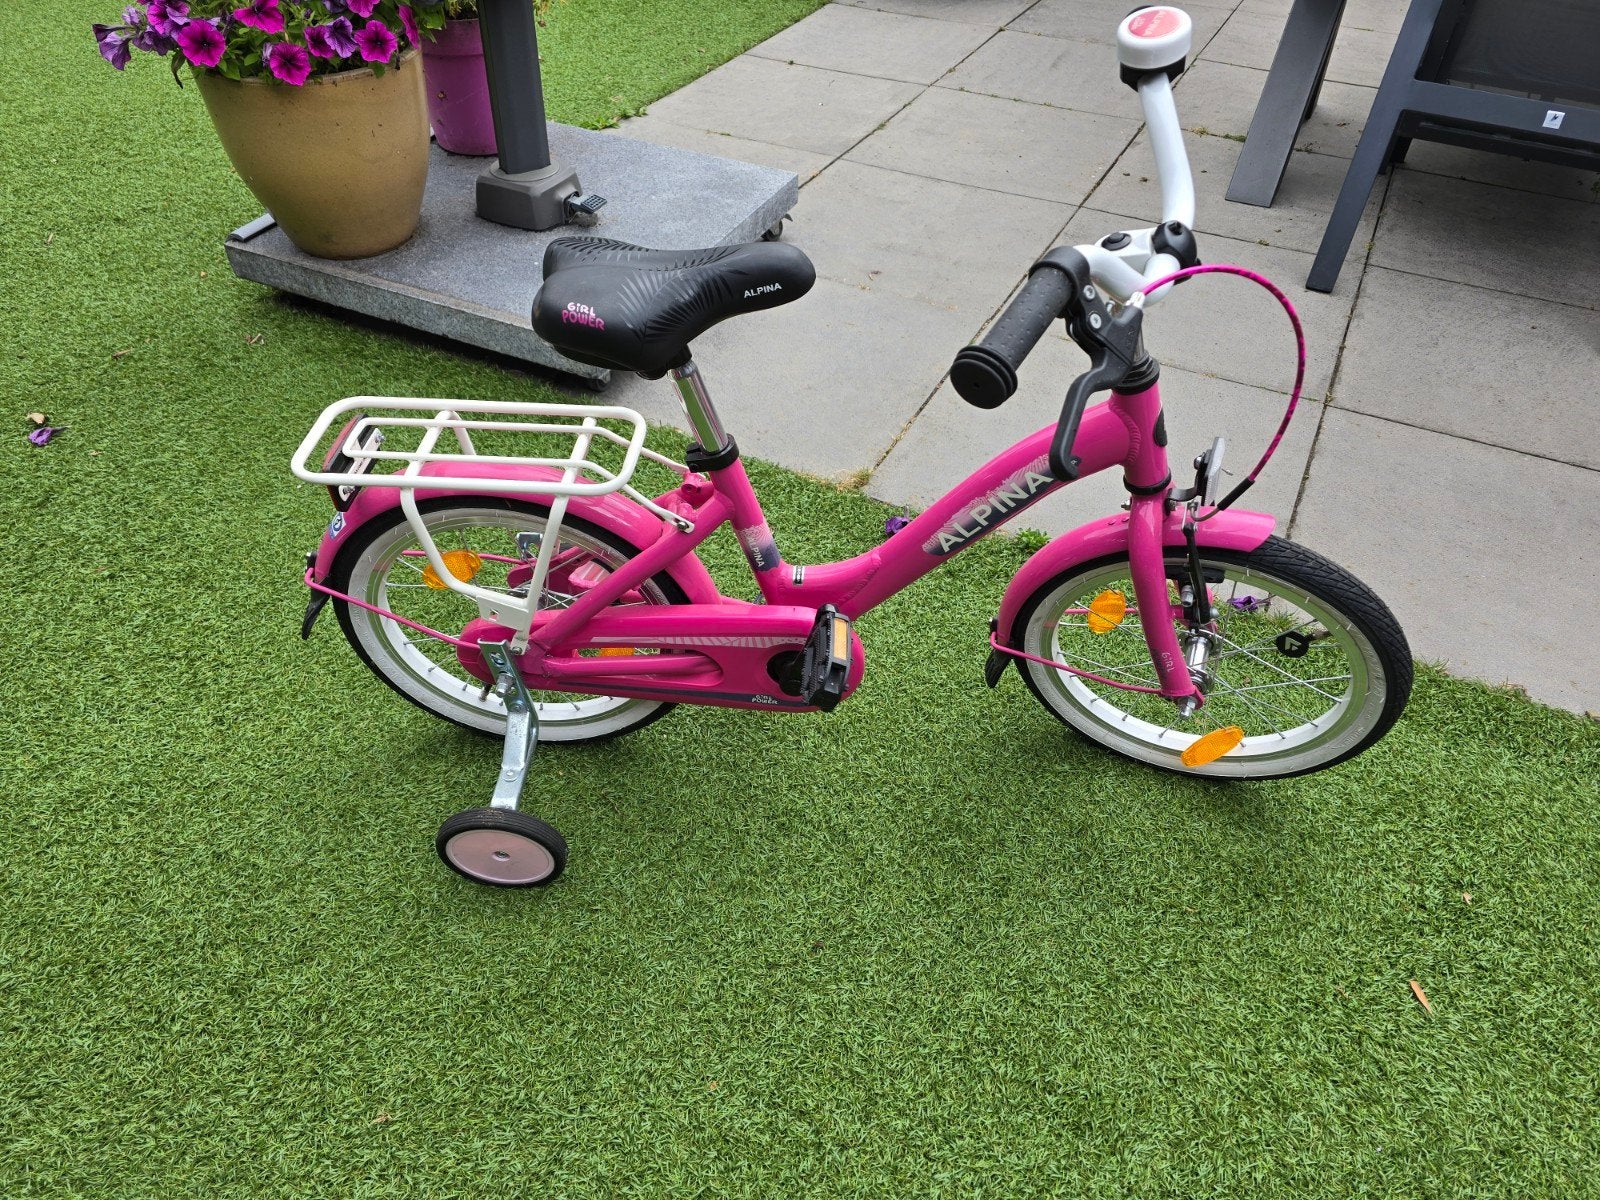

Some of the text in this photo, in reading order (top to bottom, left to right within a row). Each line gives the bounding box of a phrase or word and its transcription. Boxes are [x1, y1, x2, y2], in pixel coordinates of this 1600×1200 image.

[743, 282, 783, 299] ALPINA
[562, 309, 605, 331] POWER
[938, 470, 1054, 553] ALPINA
